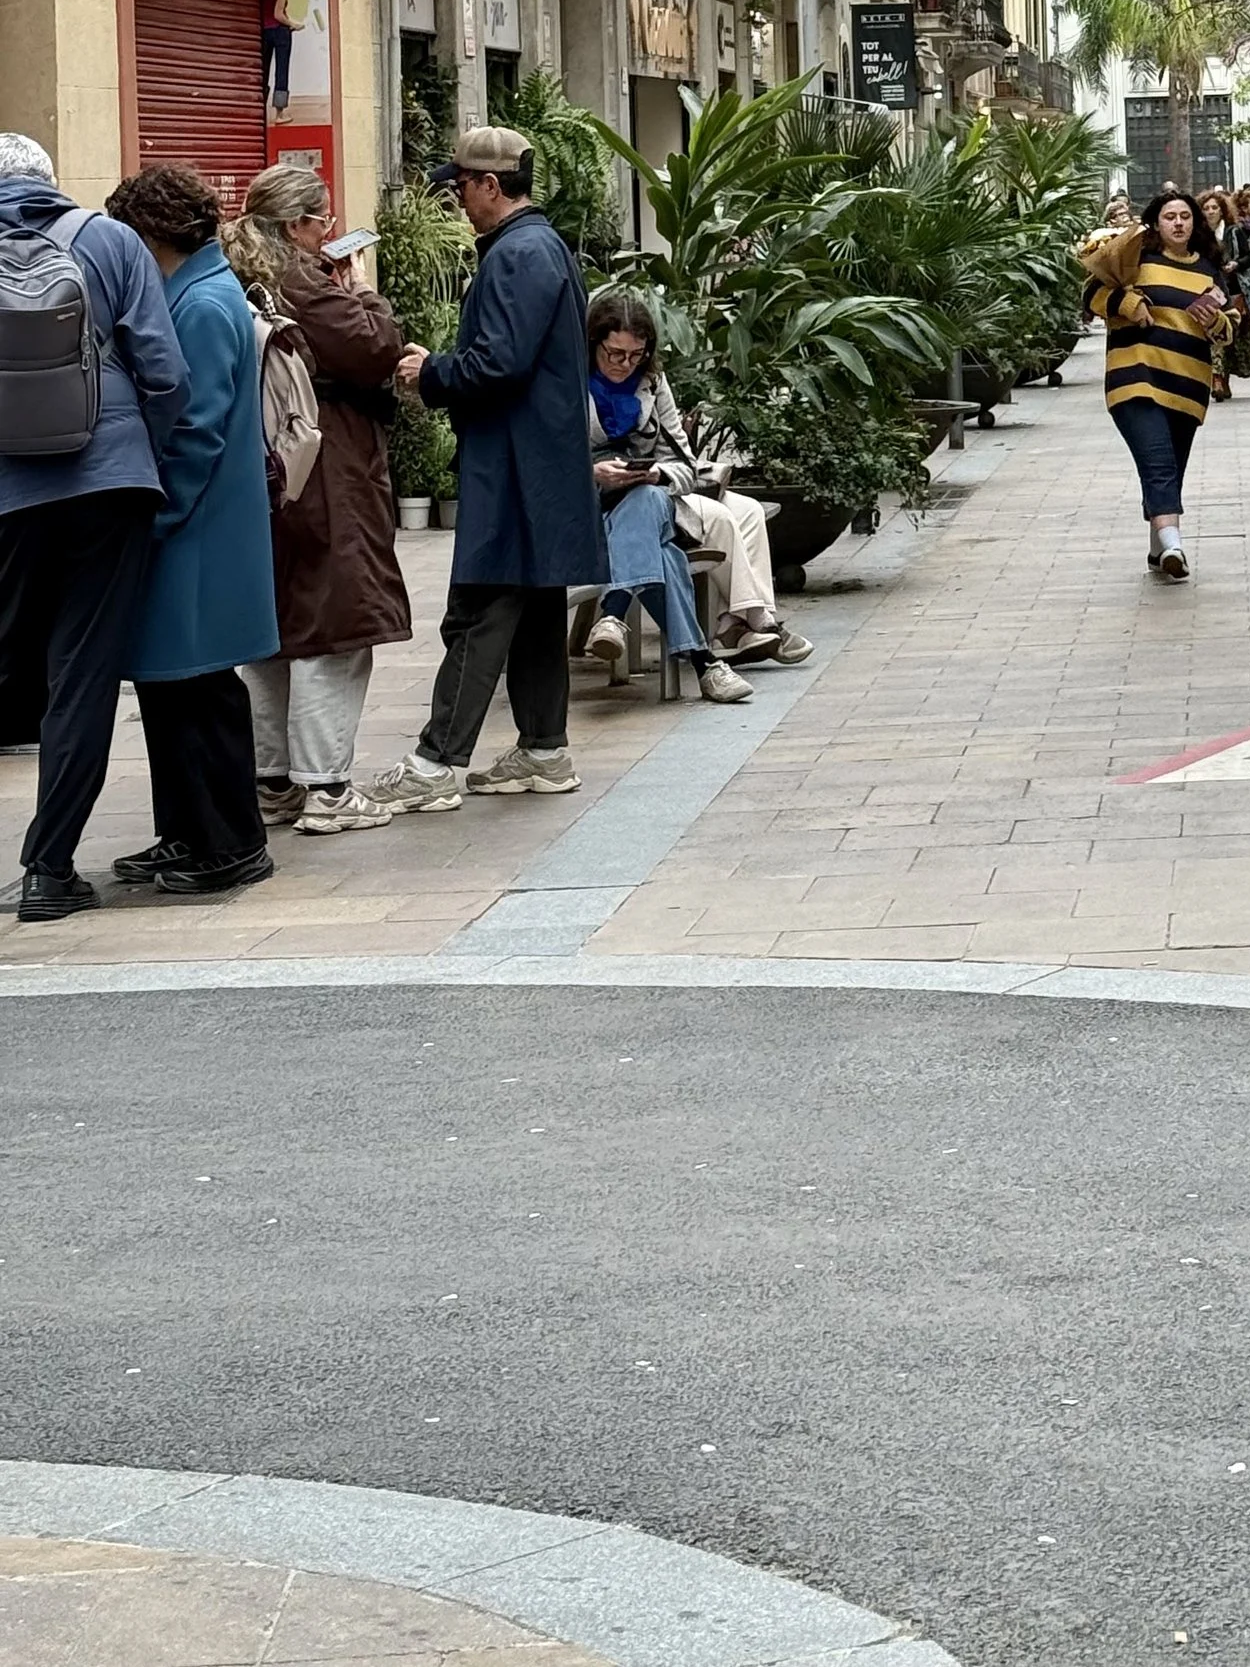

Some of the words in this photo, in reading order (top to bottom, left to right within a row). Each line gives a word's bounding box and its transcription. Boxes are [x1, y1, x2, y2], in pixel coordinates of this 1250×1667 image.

[861, 41, 879, 51] TOT
[862, 53, 880, 63] PER
[881, 52, 894, 62] AL
[862, 65, 879, 74] TEU
